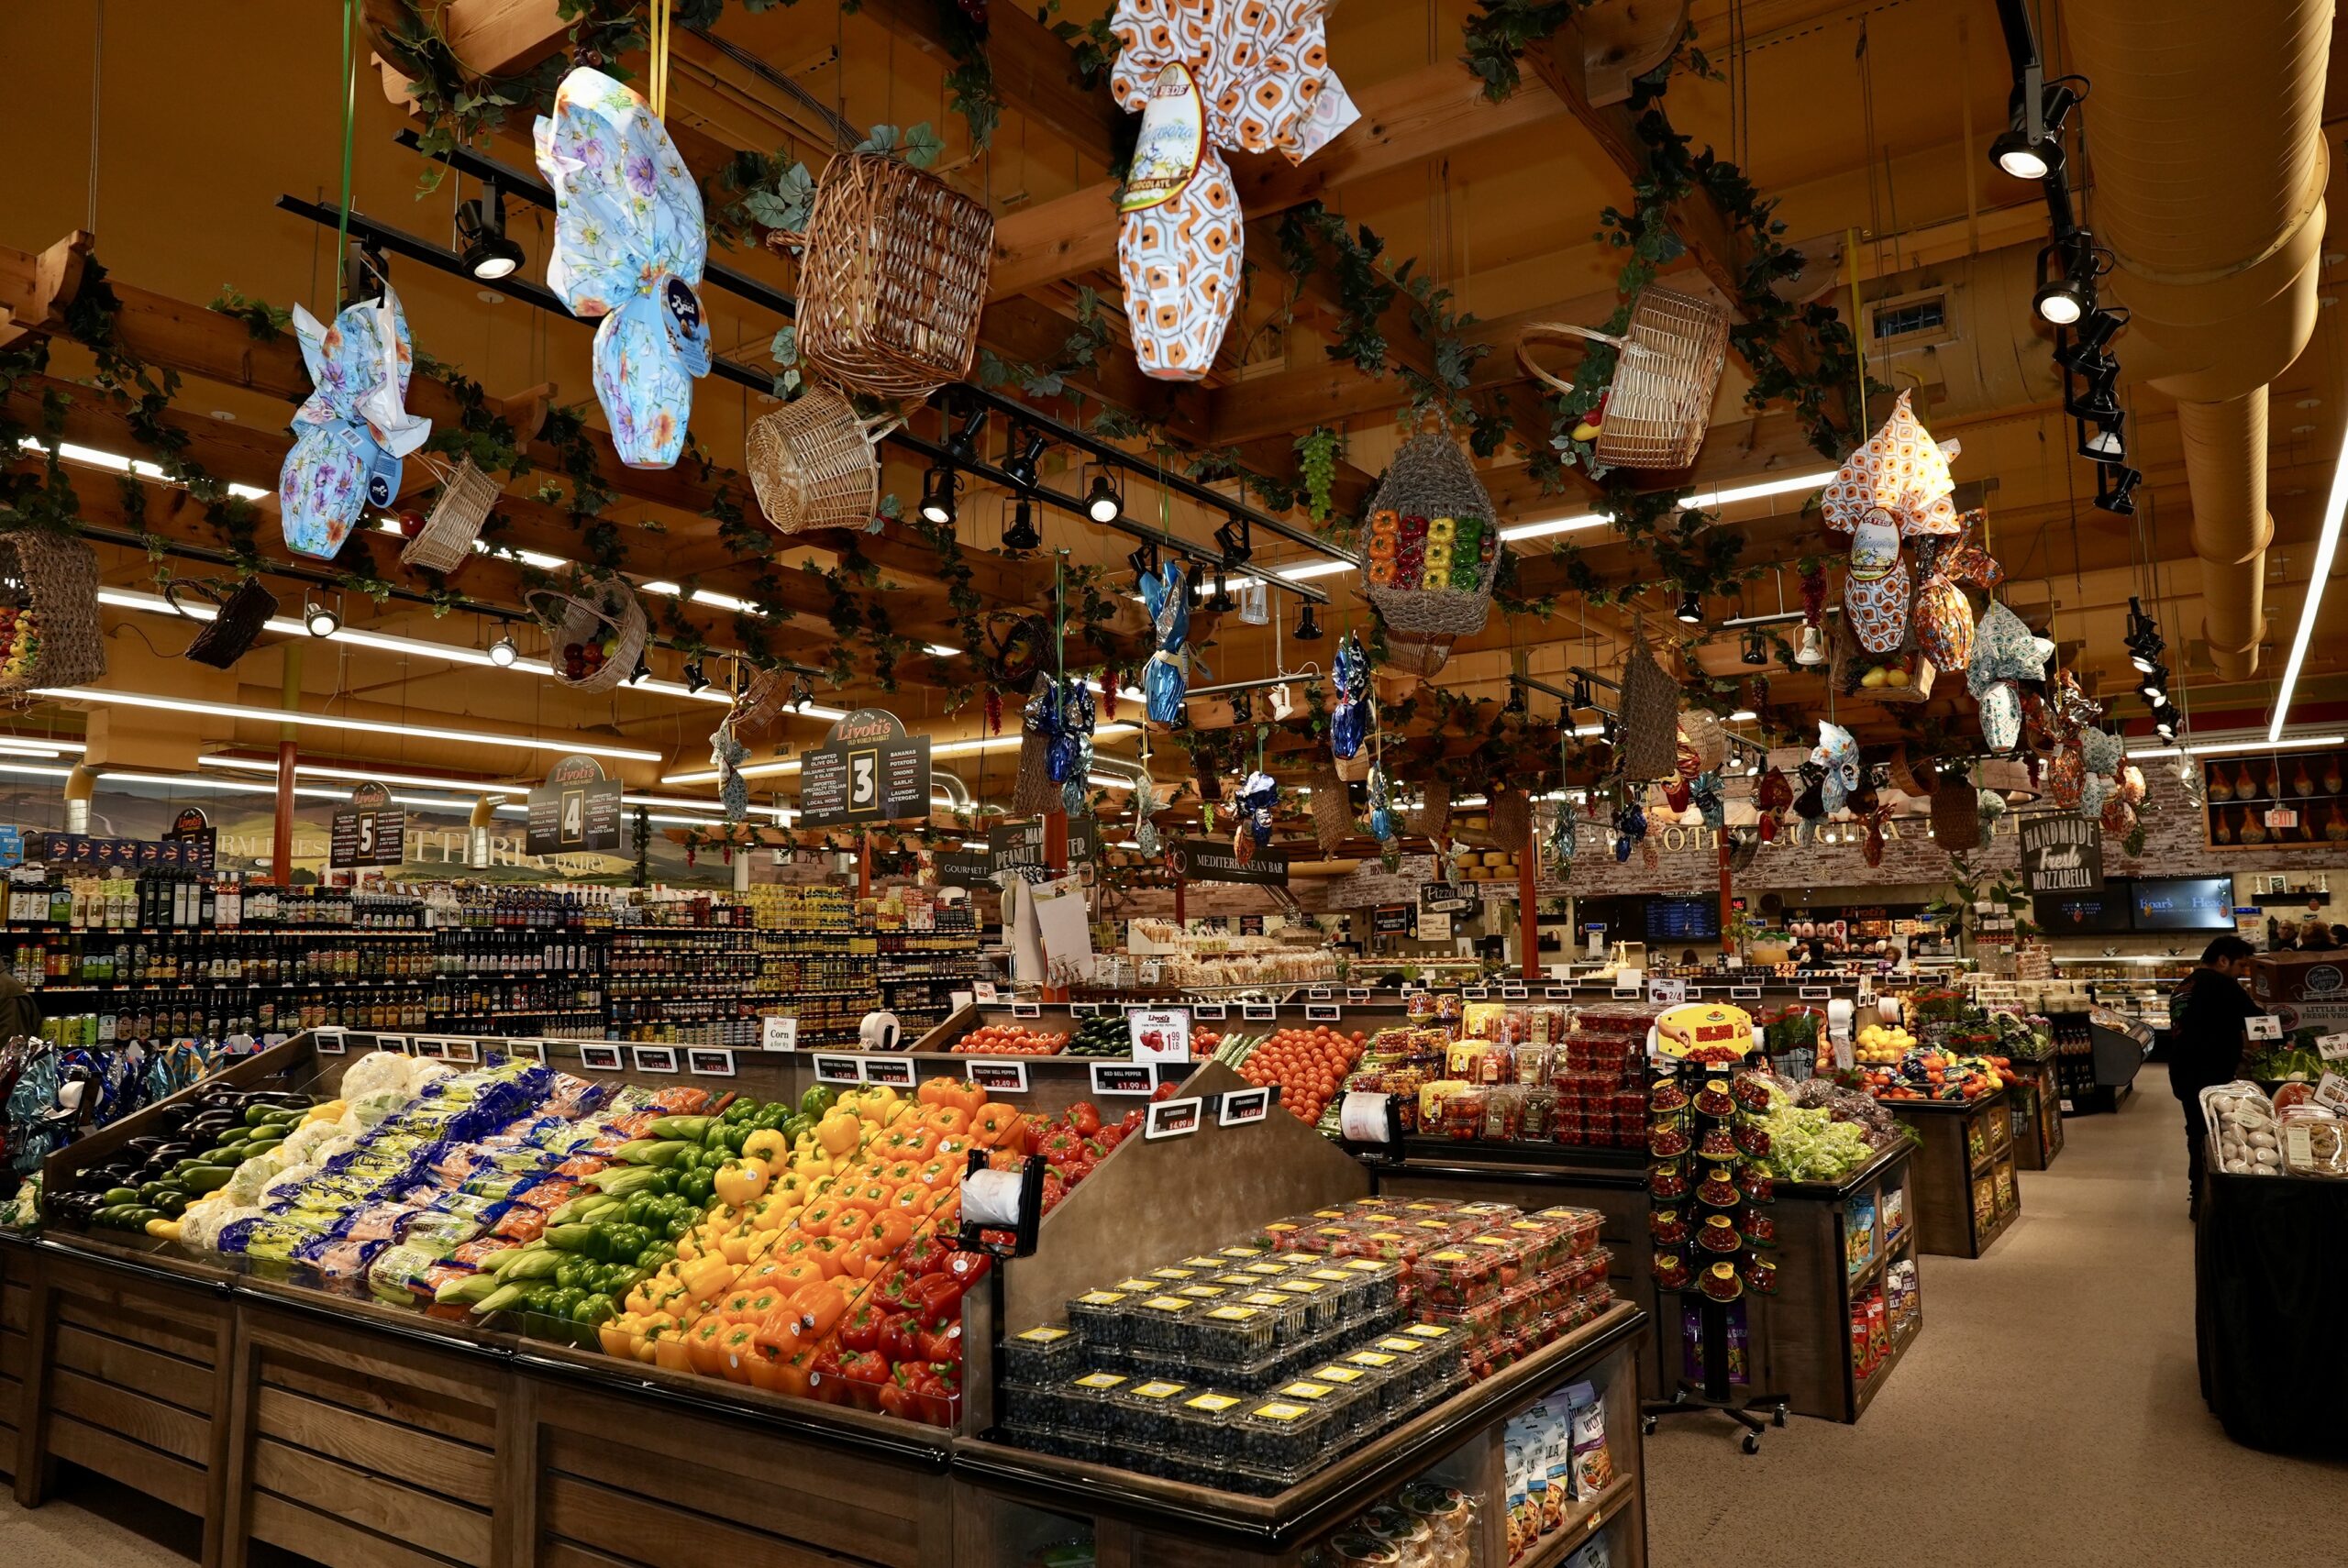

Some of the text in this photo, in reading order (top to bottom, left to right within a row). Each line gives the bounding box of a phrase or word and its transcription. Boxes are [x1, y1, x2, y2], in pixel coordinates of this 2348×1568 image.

[671, 294, 694, 315] Baci
[836, 718, 892, 741] Livoti's
[872, 734, 890, 743] MARKET
[812, 753, 836, 761] IMPORTED
[890, 749, 916, 757] BANANAS
[555, 764, 595, 782] Livoti's
[853, 758, 873, 802] 3
[354, 790, 385, 805] Livoti's
[887, 794, 919, 802] DETERGENT
[564, 798, 581, 835] 4
[805, 806, 844, 814] MEDITERRANEAN
[2271, 811, 2293, 826] EXIT
[360, 818, 372, 852] 5
[2024, 821, 2095, 853] HANDMADE
[555, 854, 607, 871] DAIRY
[995, 845, 1036, 869] PEANUT
[2040, 845, 2082, 871] Fresh
[945, 865, 982, 875] GOURMET
[1268, 862, 1283, 874] BAR
[2032, 868, 2091, 890] MOZZARELLA
[1423, 884, 1476, 900] Pizza BAR
[1668, 991, 1682, 1001] 2/4
[1148, 1014, 1170, 1022] Livoti's
[770, 1030, 789, 1039] Corn
[1172, 1042, 1180, 1050] LB
[1240, 1109, 1256, 1117] $4.49
[1168, 1121, 1187, 1130] $4.99
